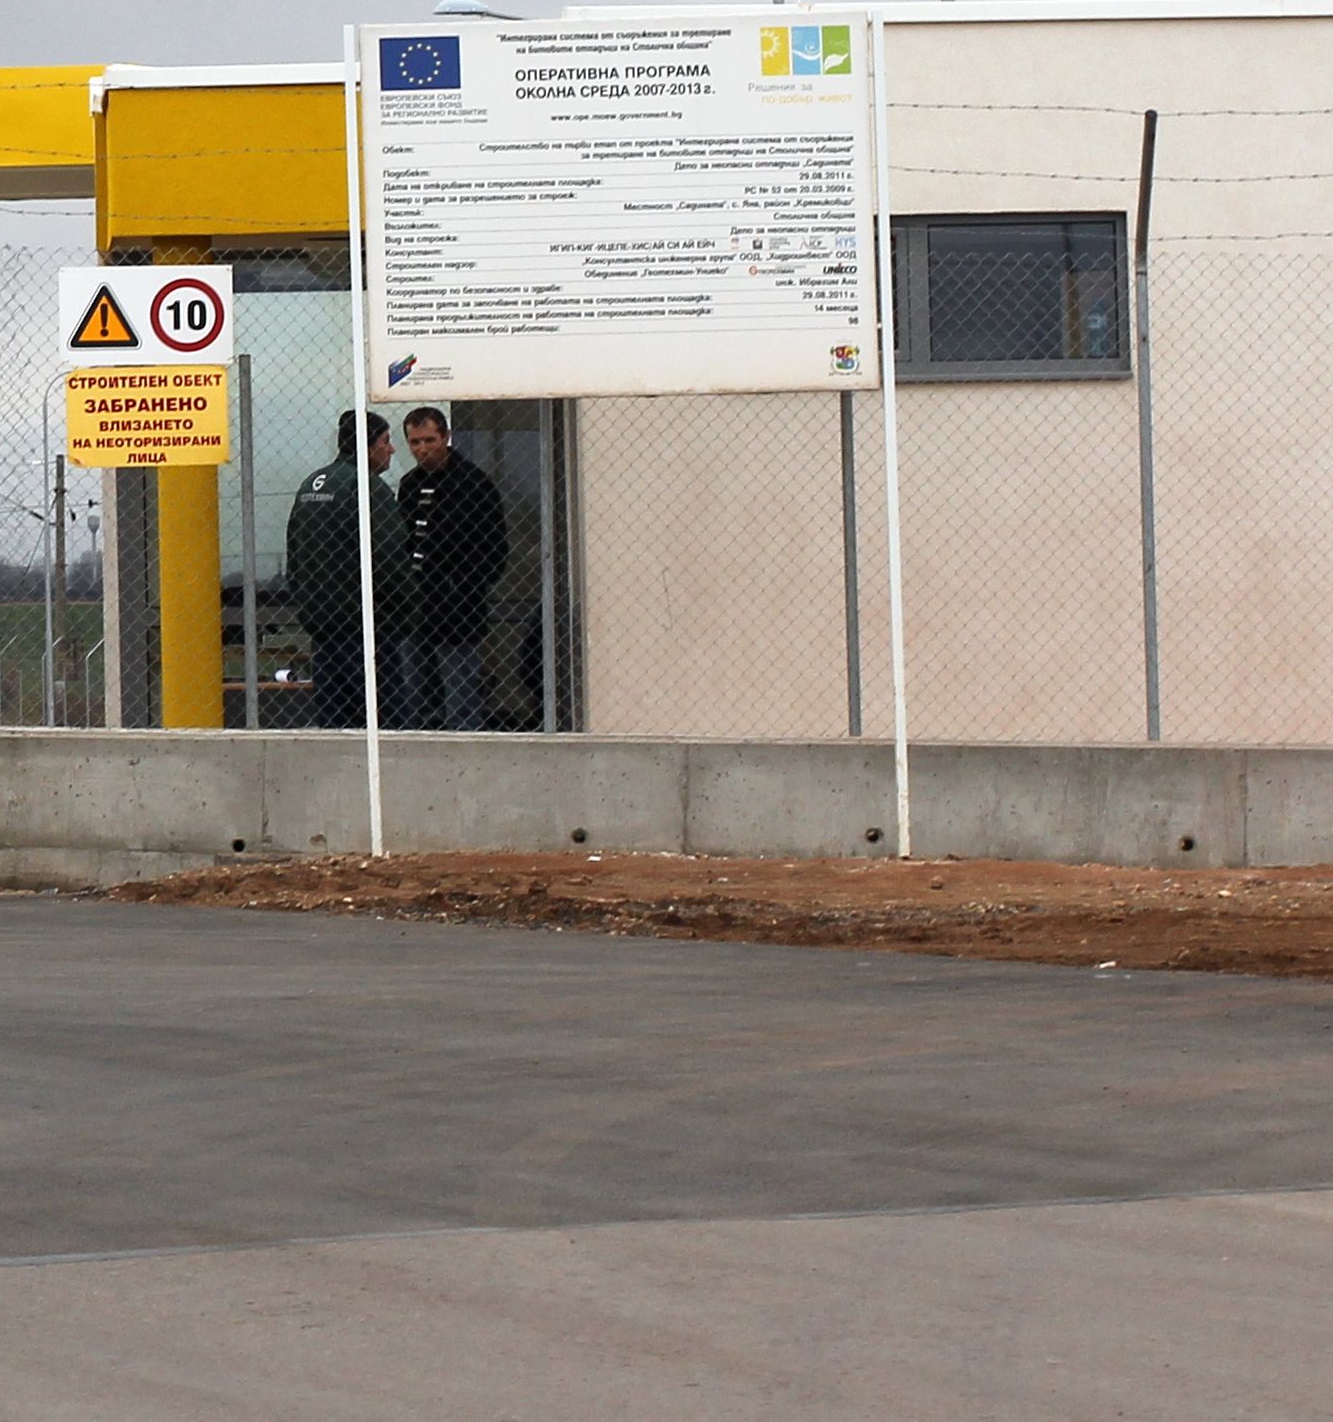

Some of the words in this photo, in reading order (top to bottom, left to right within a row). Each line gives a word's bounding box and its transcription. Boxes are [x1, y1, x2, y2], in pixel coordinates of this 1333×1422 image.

[515, 67, 619, 82] ОПЕРАТИВНА
[625, 64, 711, 79] ПРОГРАМА
[515, 84, 576, 100] ОКОЛНА
[580, 84, 630, 99] СРЕДА
[634, 82, 701, 97] 2007-2013
[166, 300, 207, 331] 10
[69, 375, 168, 390] СТРОИТЕЛЕН
[173, 374, 223, 387] ОБЕКТ
[84, 397, 207, 414] ЗАБРАНЕНО
[99, 419, 194, 432] ВЛИЗАНЕТО
[73, 438, 92, 448] НА
[96, 436, 221, 448] НЕОТОРИЗИРАНИ
[127, 453, 167, 464] ЛИЦА
